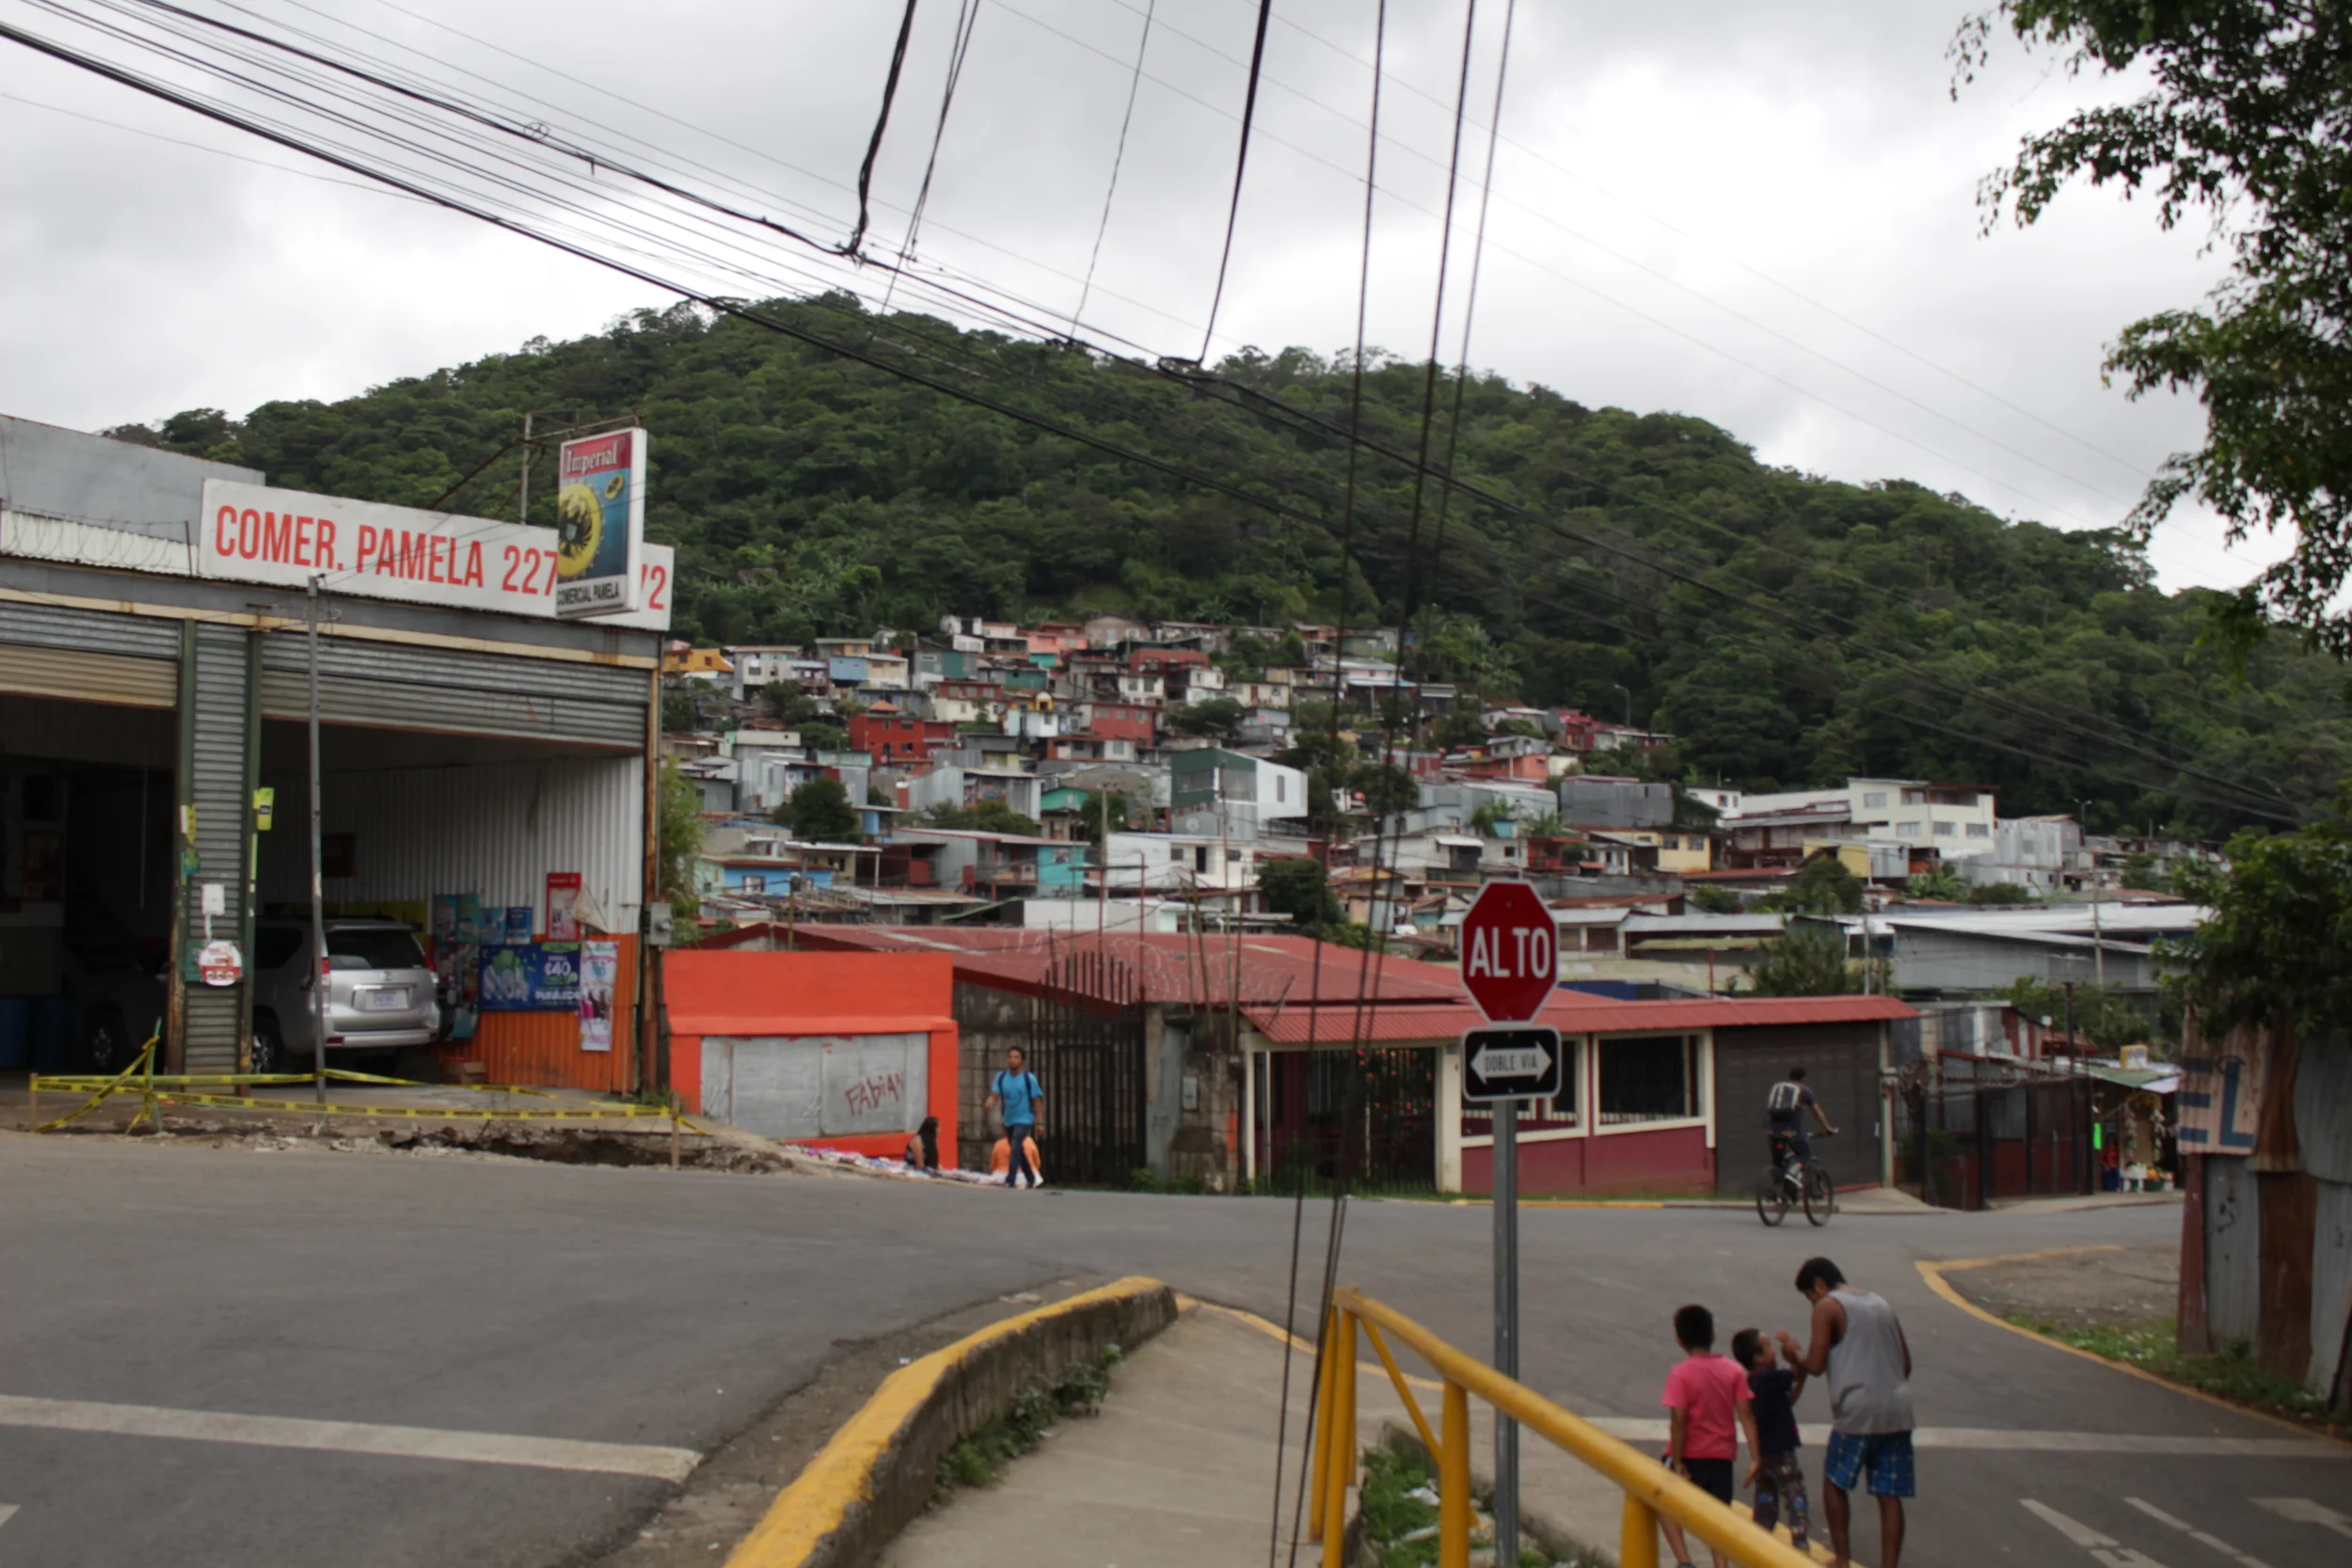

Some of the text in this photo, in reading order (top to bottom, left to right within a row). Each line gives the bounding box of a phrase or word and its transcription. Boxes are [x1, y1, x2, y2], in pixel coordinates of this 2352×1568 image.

[564, 440, 619, 475] Imperial
[215, 505, 344, 571] COMER.
[356, 523, 485, 588] PAMELA
[1469, 926, 1551, 979] ALTO
[1484, 1054, 1517, 1073] DOBLE
